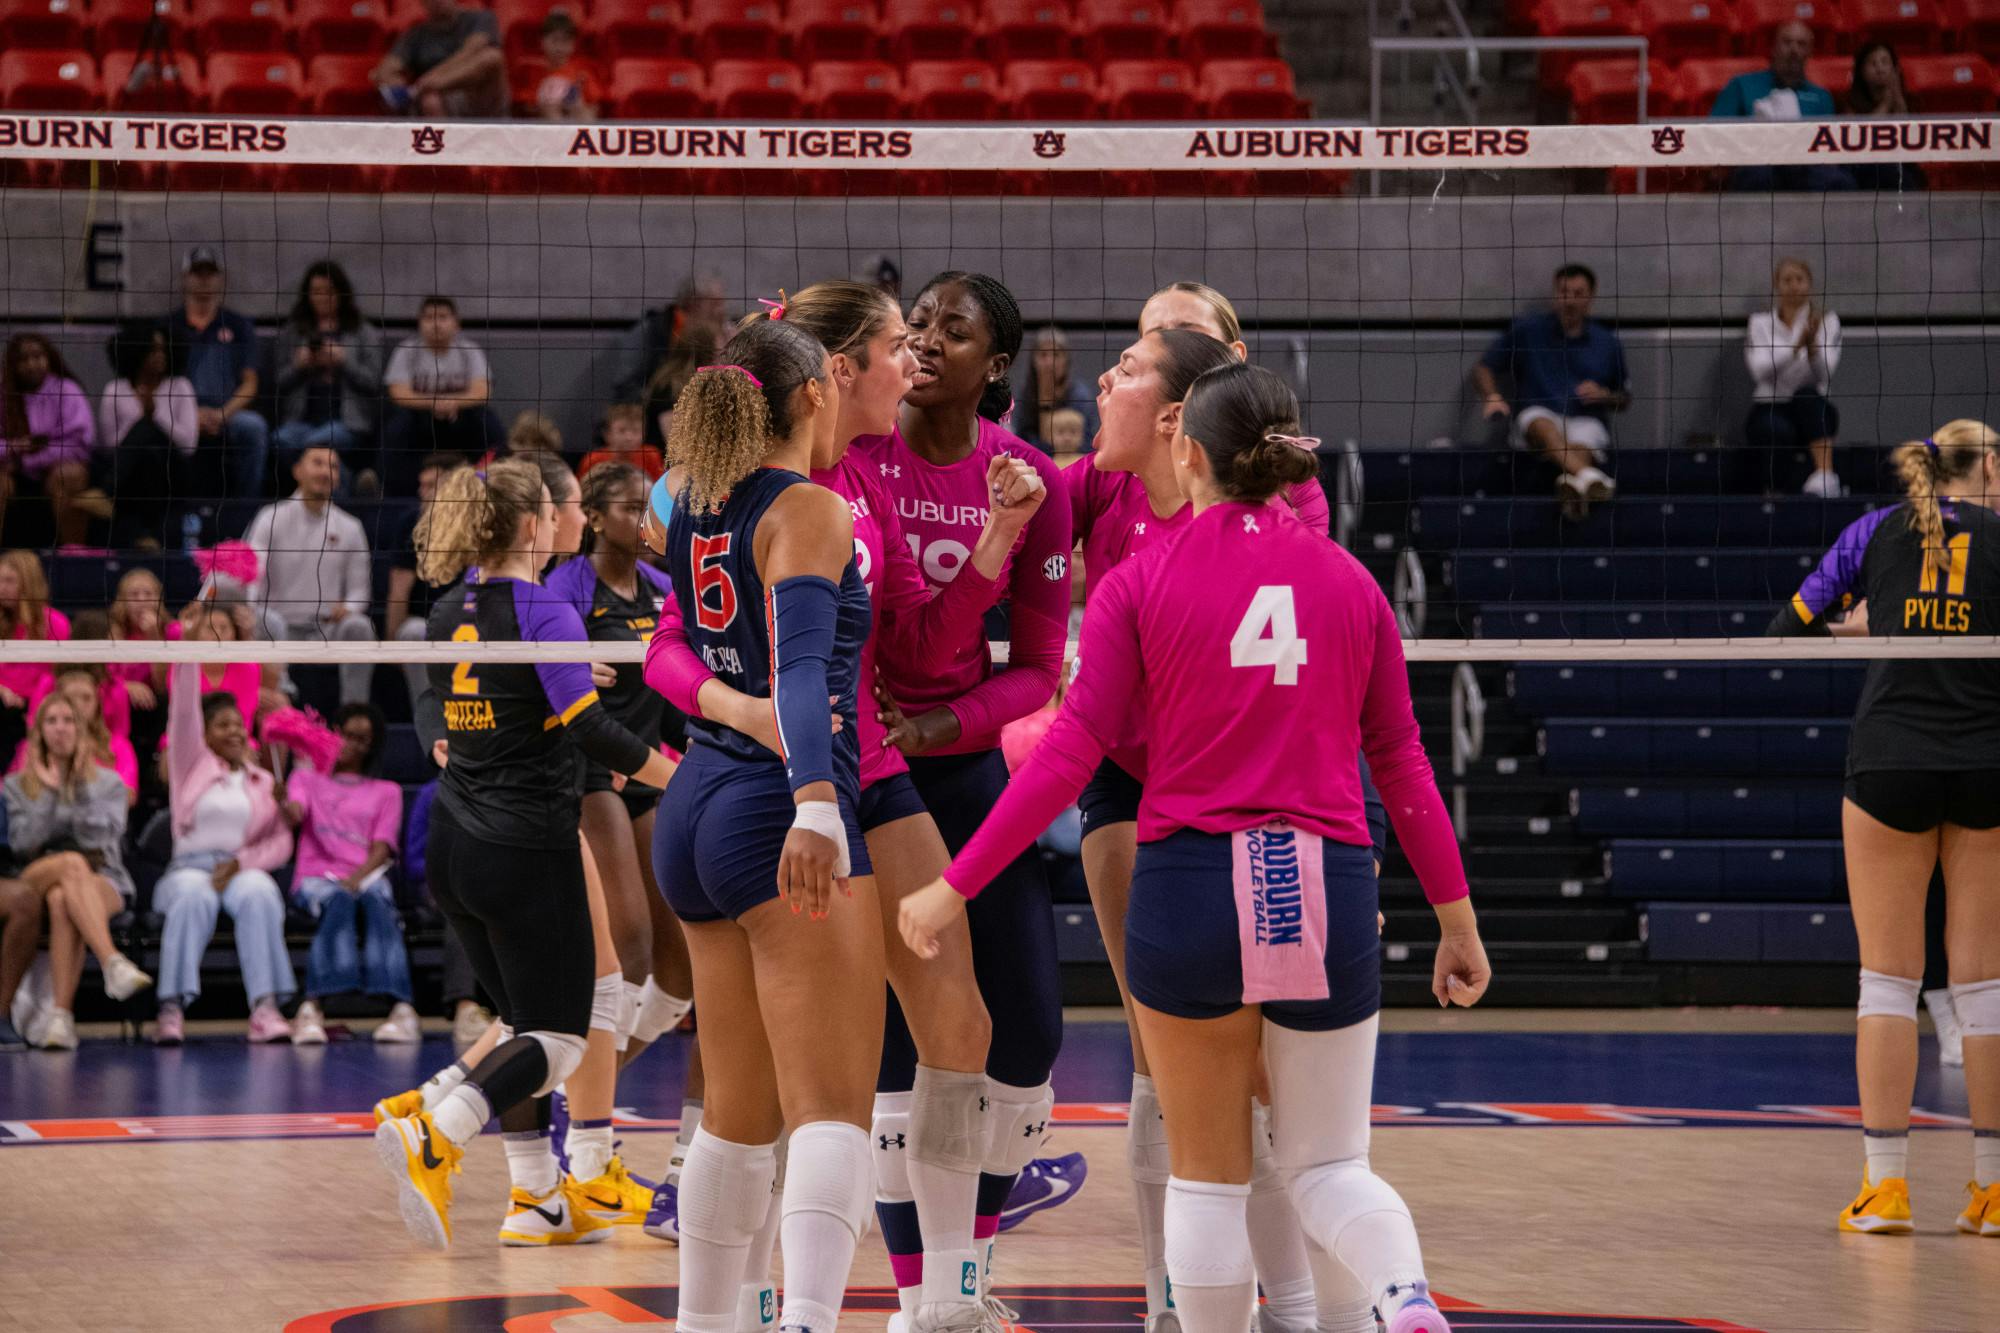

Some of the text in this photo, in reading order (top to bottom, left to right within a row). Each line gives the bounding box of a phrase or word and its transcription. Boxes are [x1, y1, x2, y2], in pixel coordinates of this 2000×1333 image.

[127, 121, 287, 151] TIGERS
[568, 129, 912, 158] AUBURN TIGERS
[1185, 128, 1529, 157] AUBURN TIGERS
[1808, 122, 1992, 152] AUBURN
[86, 223, 124, 290] E
[691, 532, 737, 632] 5
[1042, 553, 1066, 583] SEC
[1919, 532, 1970, 595] 11
[1230, 585, 1307, 685] 4
[1904, 598, 1971, 632] PYLES
[452, 624, 479, 695] 2
[1246, 829, 1267, 946] VOLLEYBALL
[1262, 830, 1302, 947] AUBURN
